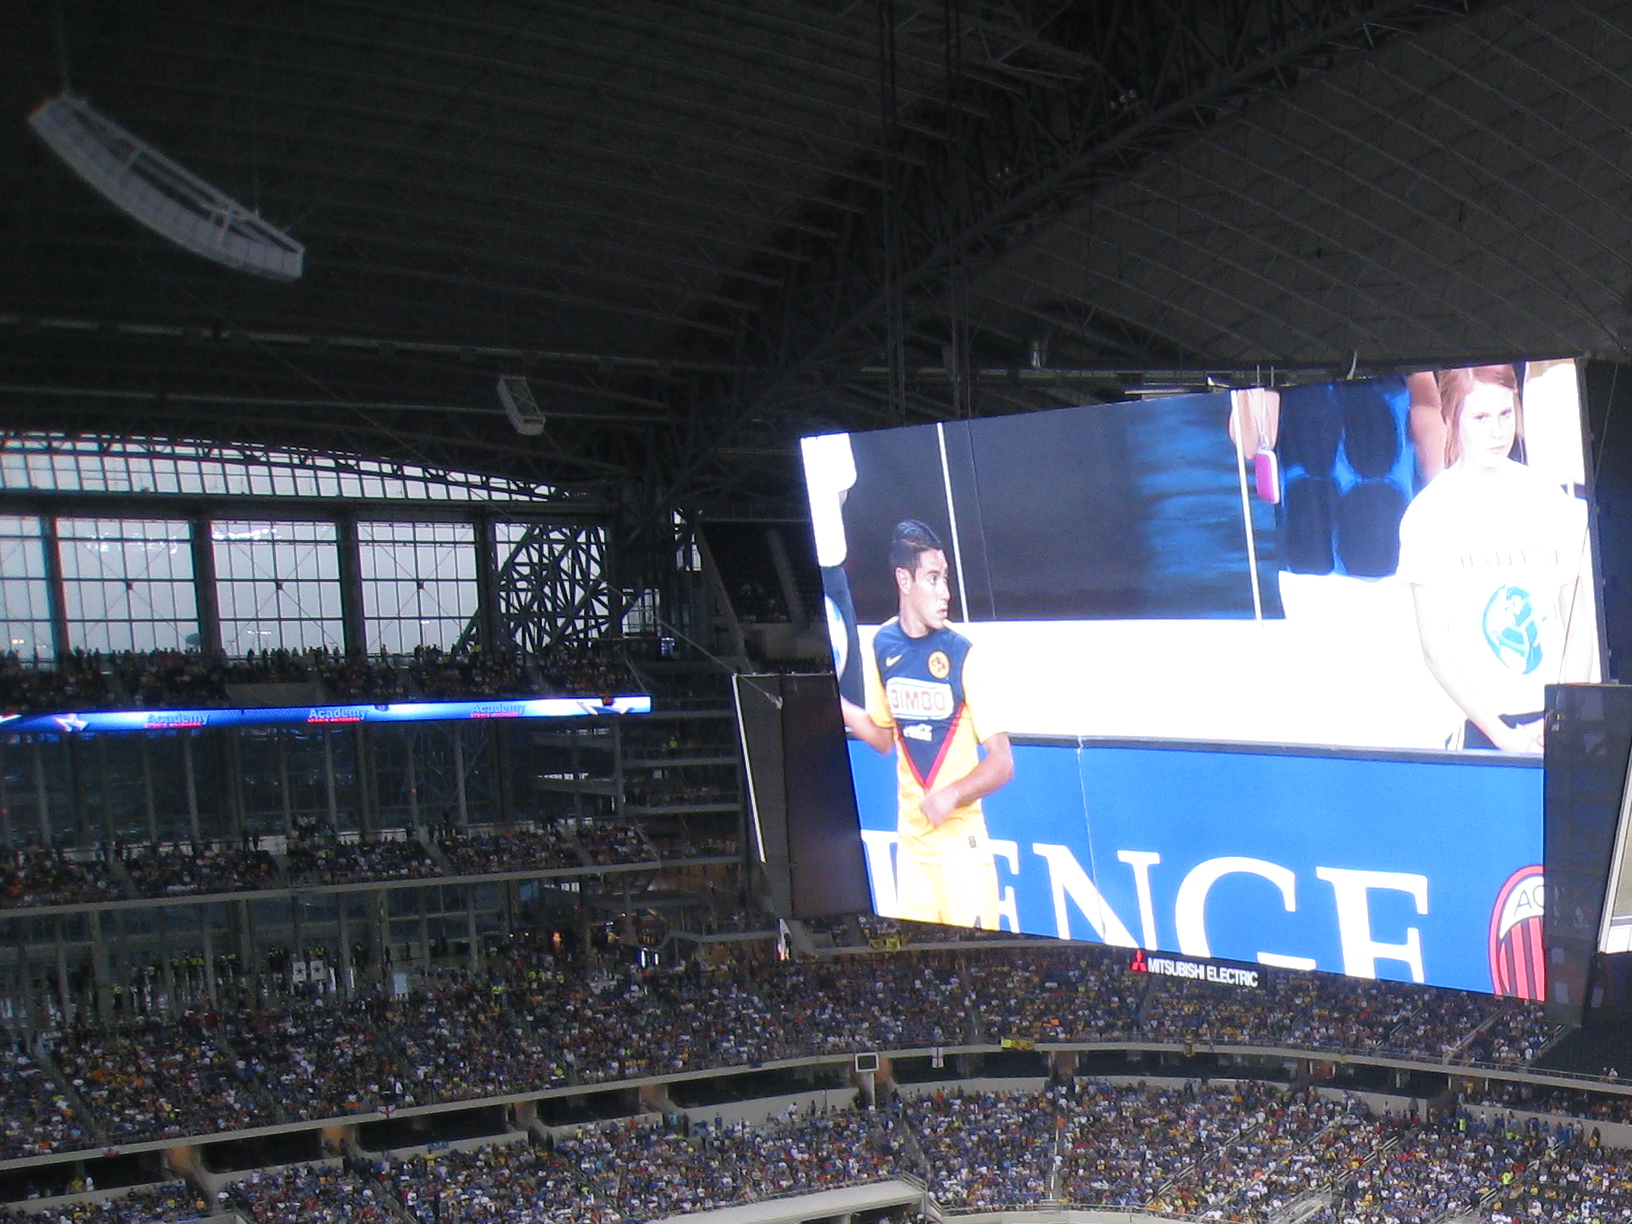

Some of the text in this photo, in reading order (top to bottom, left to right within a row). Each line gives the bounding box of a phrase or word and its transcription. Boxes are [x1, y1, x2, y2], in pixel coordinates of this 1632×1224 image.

[890, 688, 946, 711] BIMBO
[309, 707, 367, 719] Academy
[1147, 957, 1259, 988] MITSUBISHI ELECTRIC
